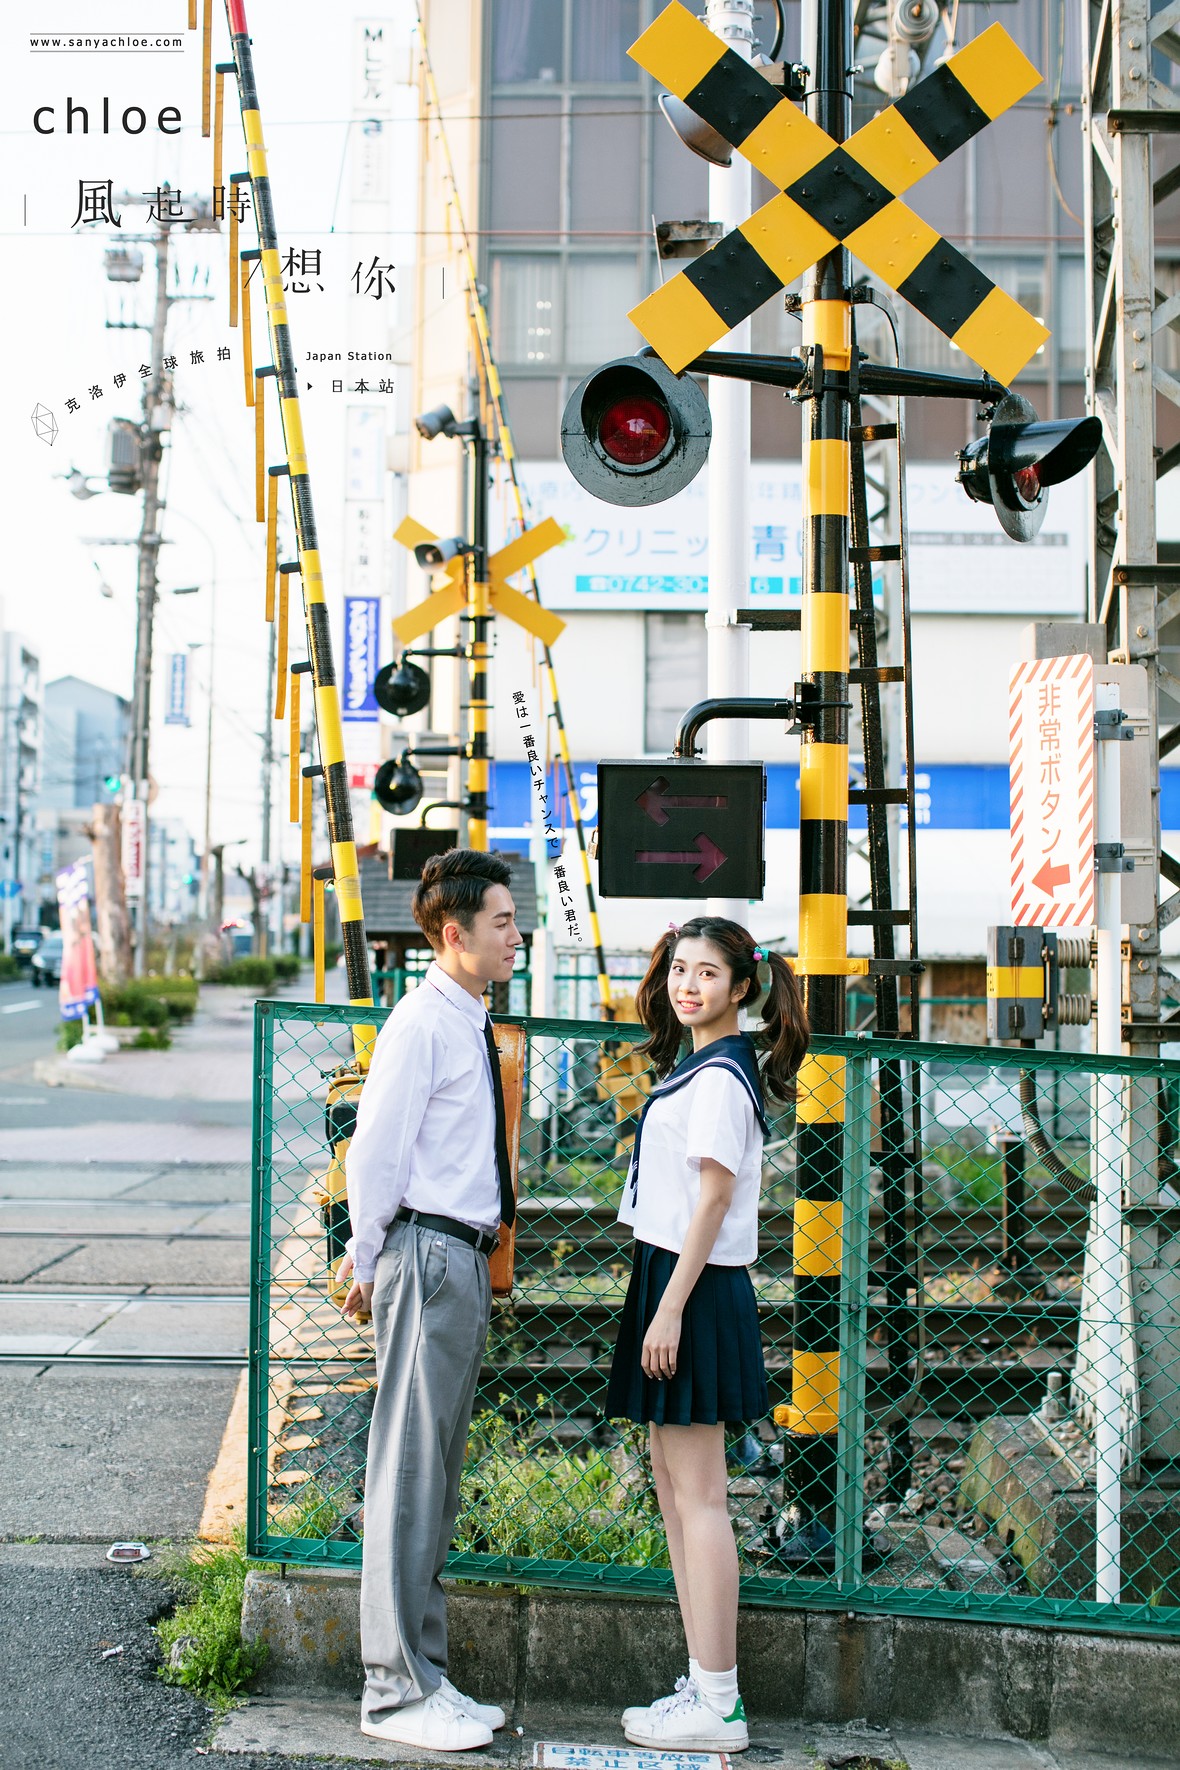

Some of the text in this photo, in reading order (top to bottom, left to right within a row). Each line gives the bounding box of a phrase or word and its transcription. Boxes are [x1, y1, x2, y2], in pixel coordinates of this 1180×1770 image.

[584, 528, 708, 557] クリニッ
[1038, 683, 1062, 854] 非常ボタン
[552, 1747, 710, 1763] 自転車等放置
